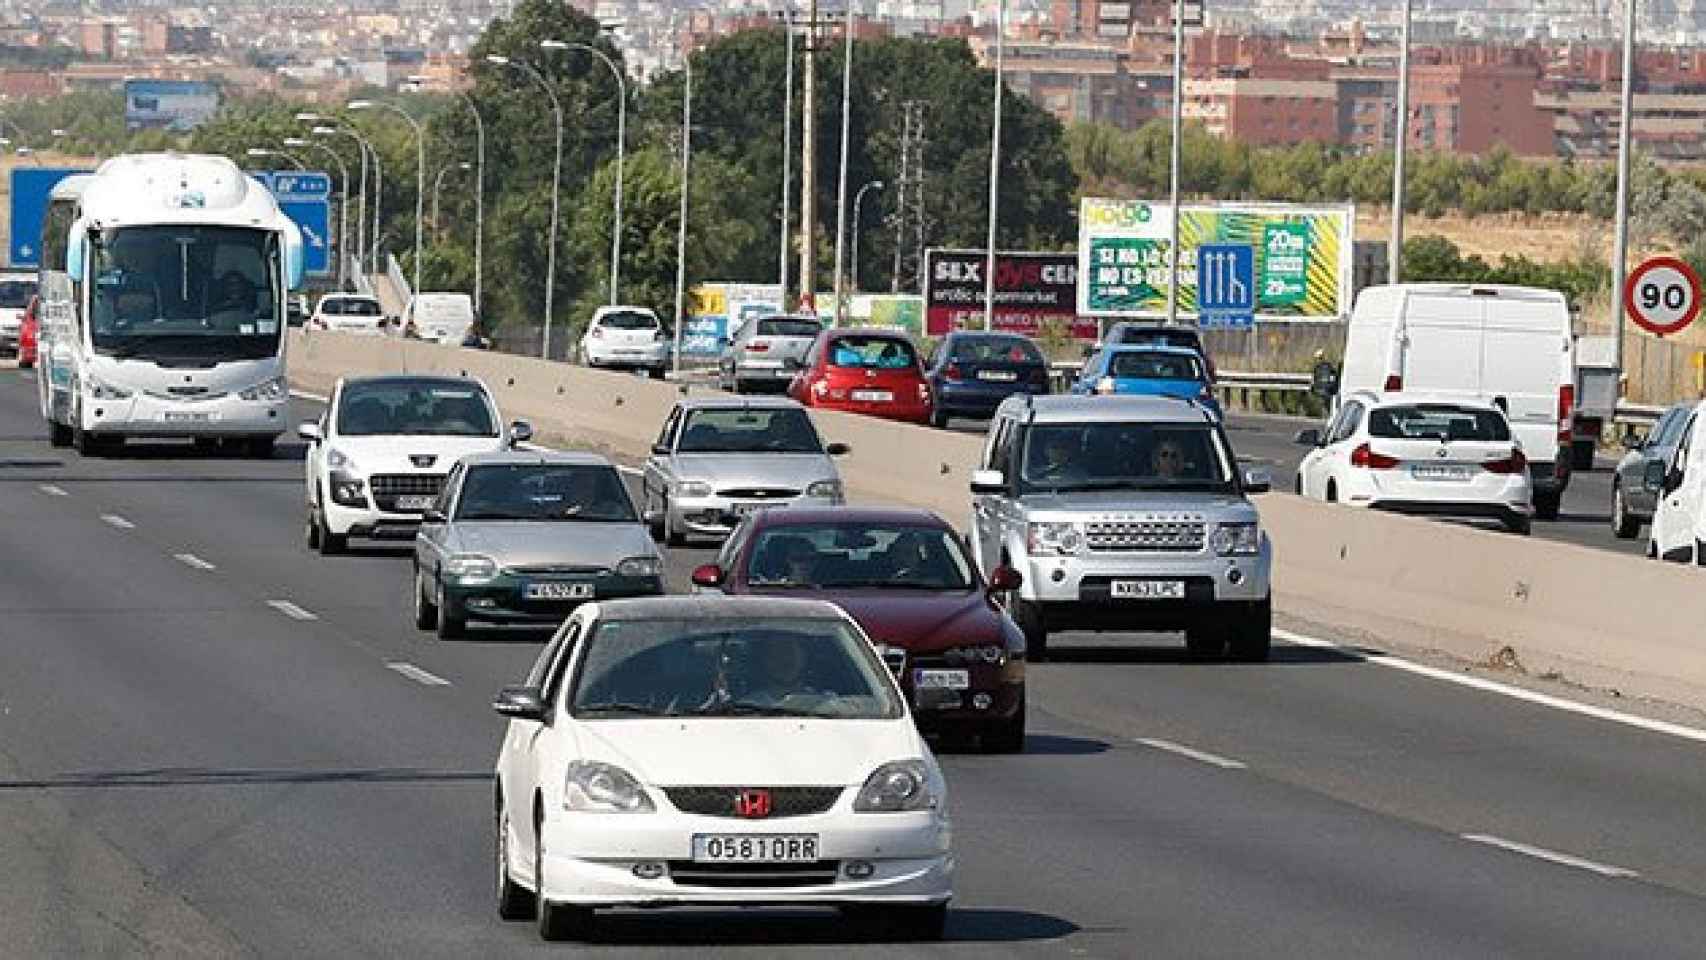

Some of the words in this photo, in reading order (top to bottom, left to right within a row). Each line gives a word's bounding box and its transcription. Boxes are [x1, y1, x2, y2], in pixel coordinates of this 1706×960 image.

[935, 261, 980, 282] SEX
[976, 291, 1058, 304] suermarket
[1641, 283, 1685, 309] 90
